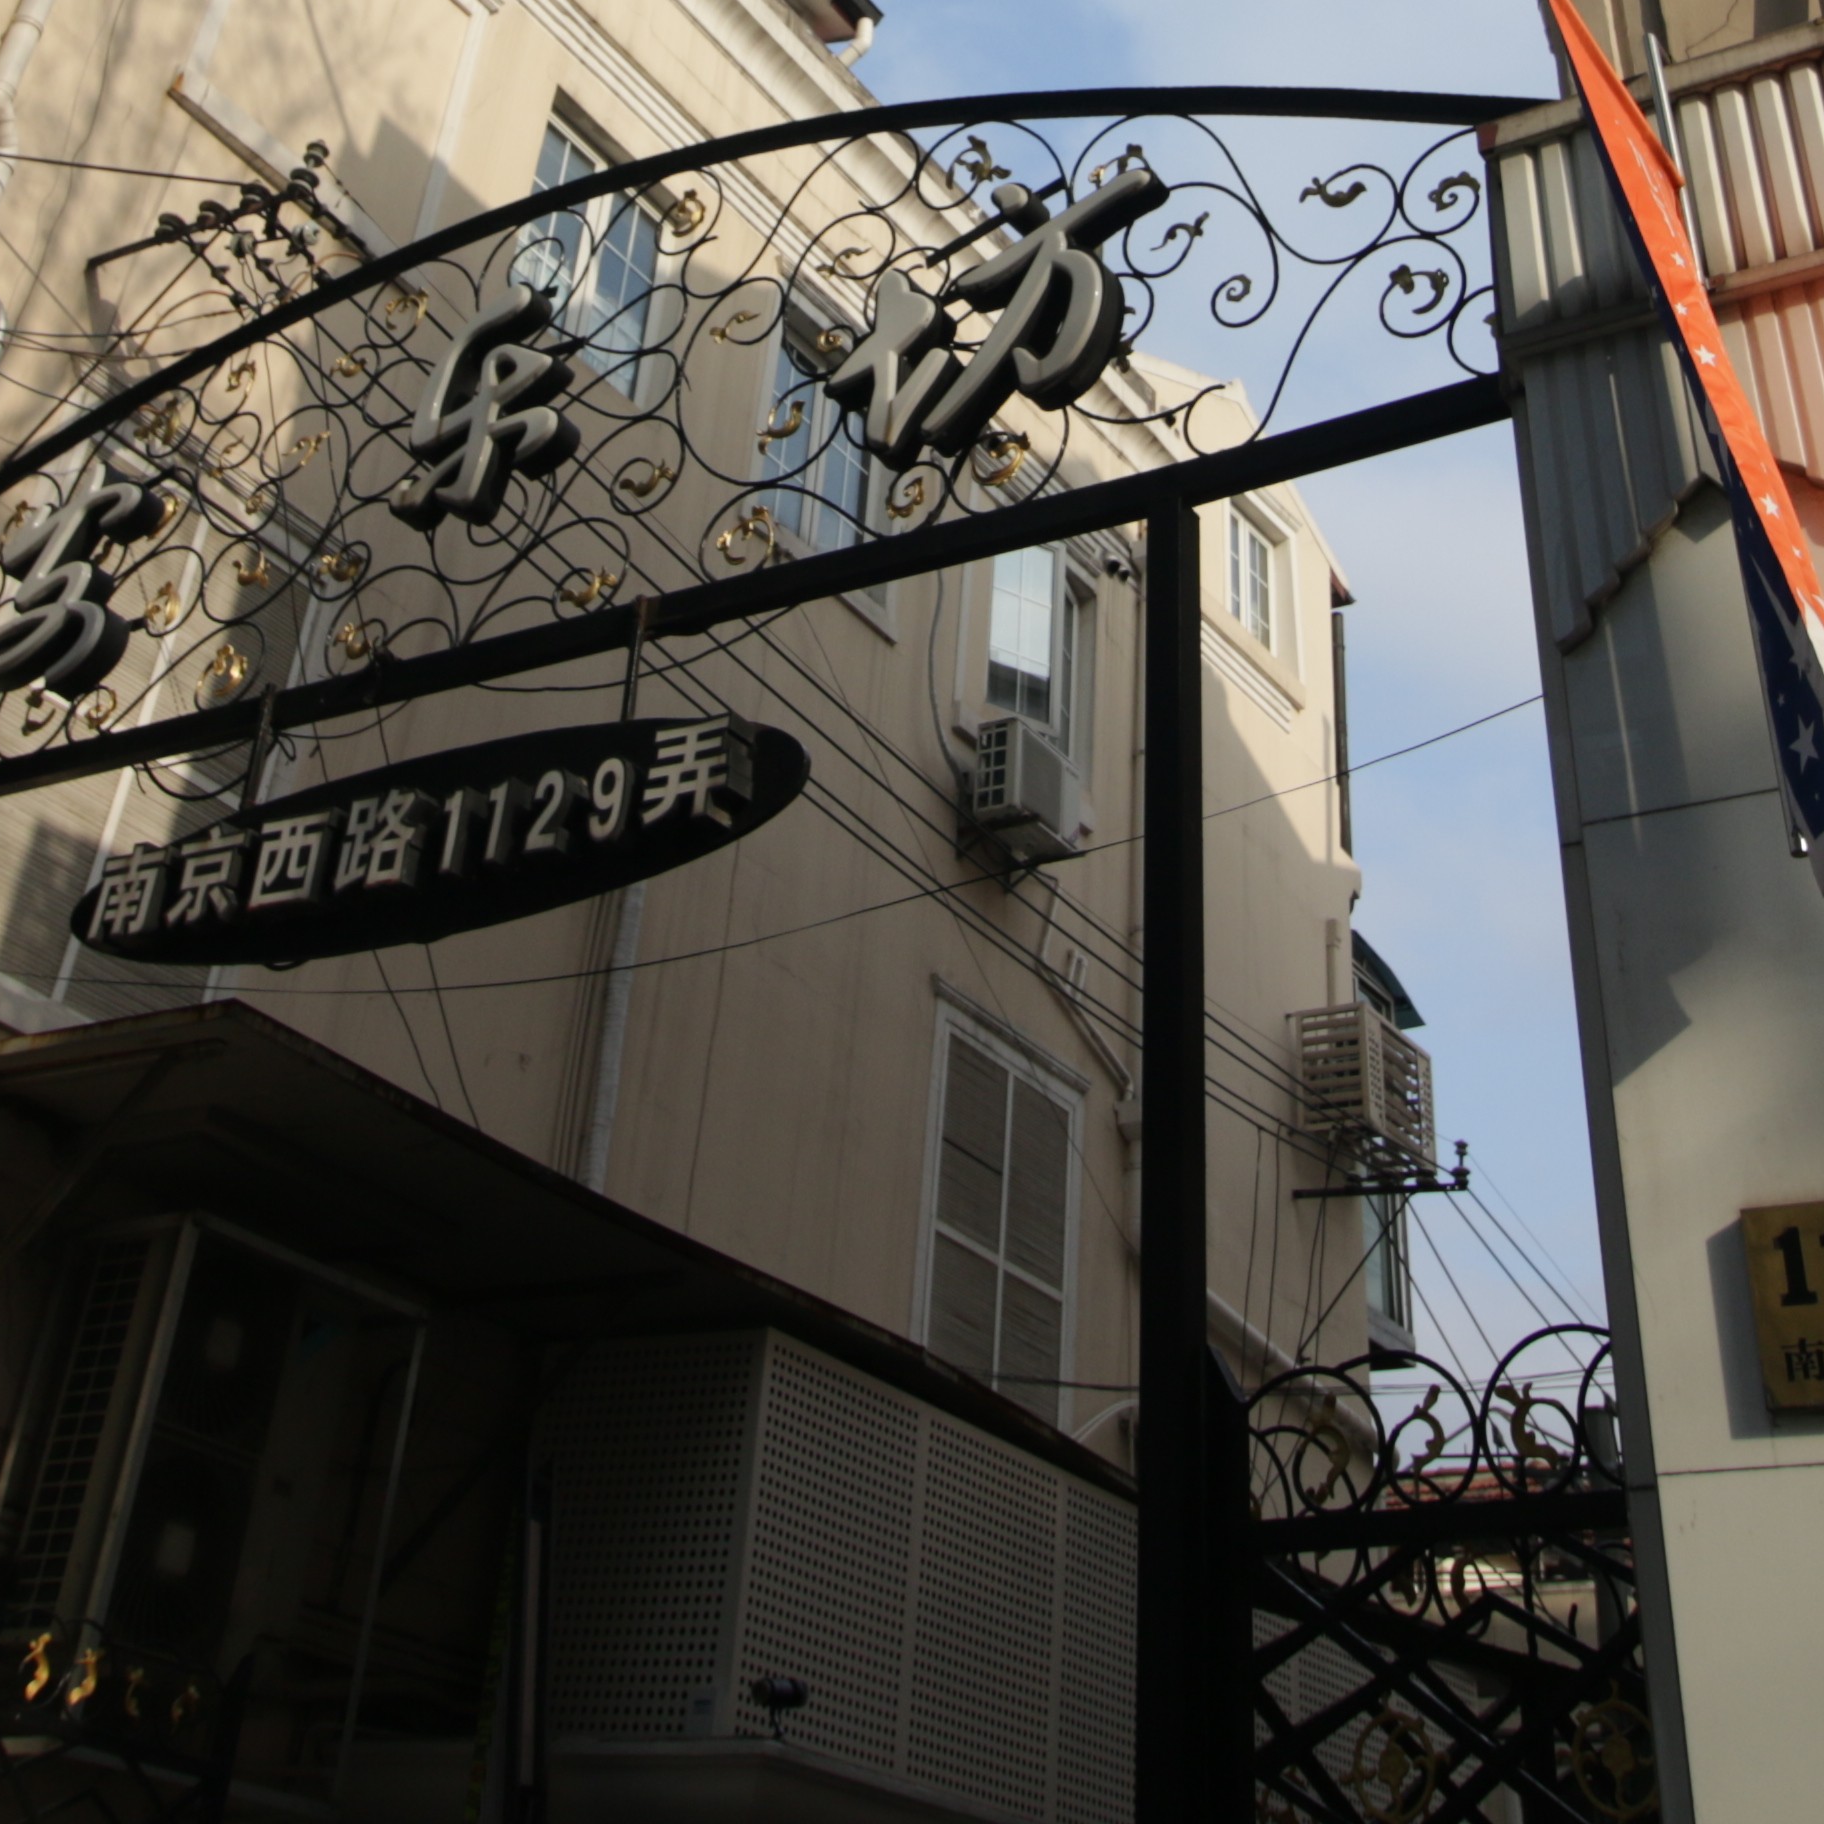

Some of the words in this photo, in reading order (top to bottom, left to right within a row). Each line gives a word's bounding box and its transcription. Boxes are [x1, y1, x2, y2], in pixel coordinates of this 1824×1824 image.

[86, 713, 753, 941] 南京西路1129弄
